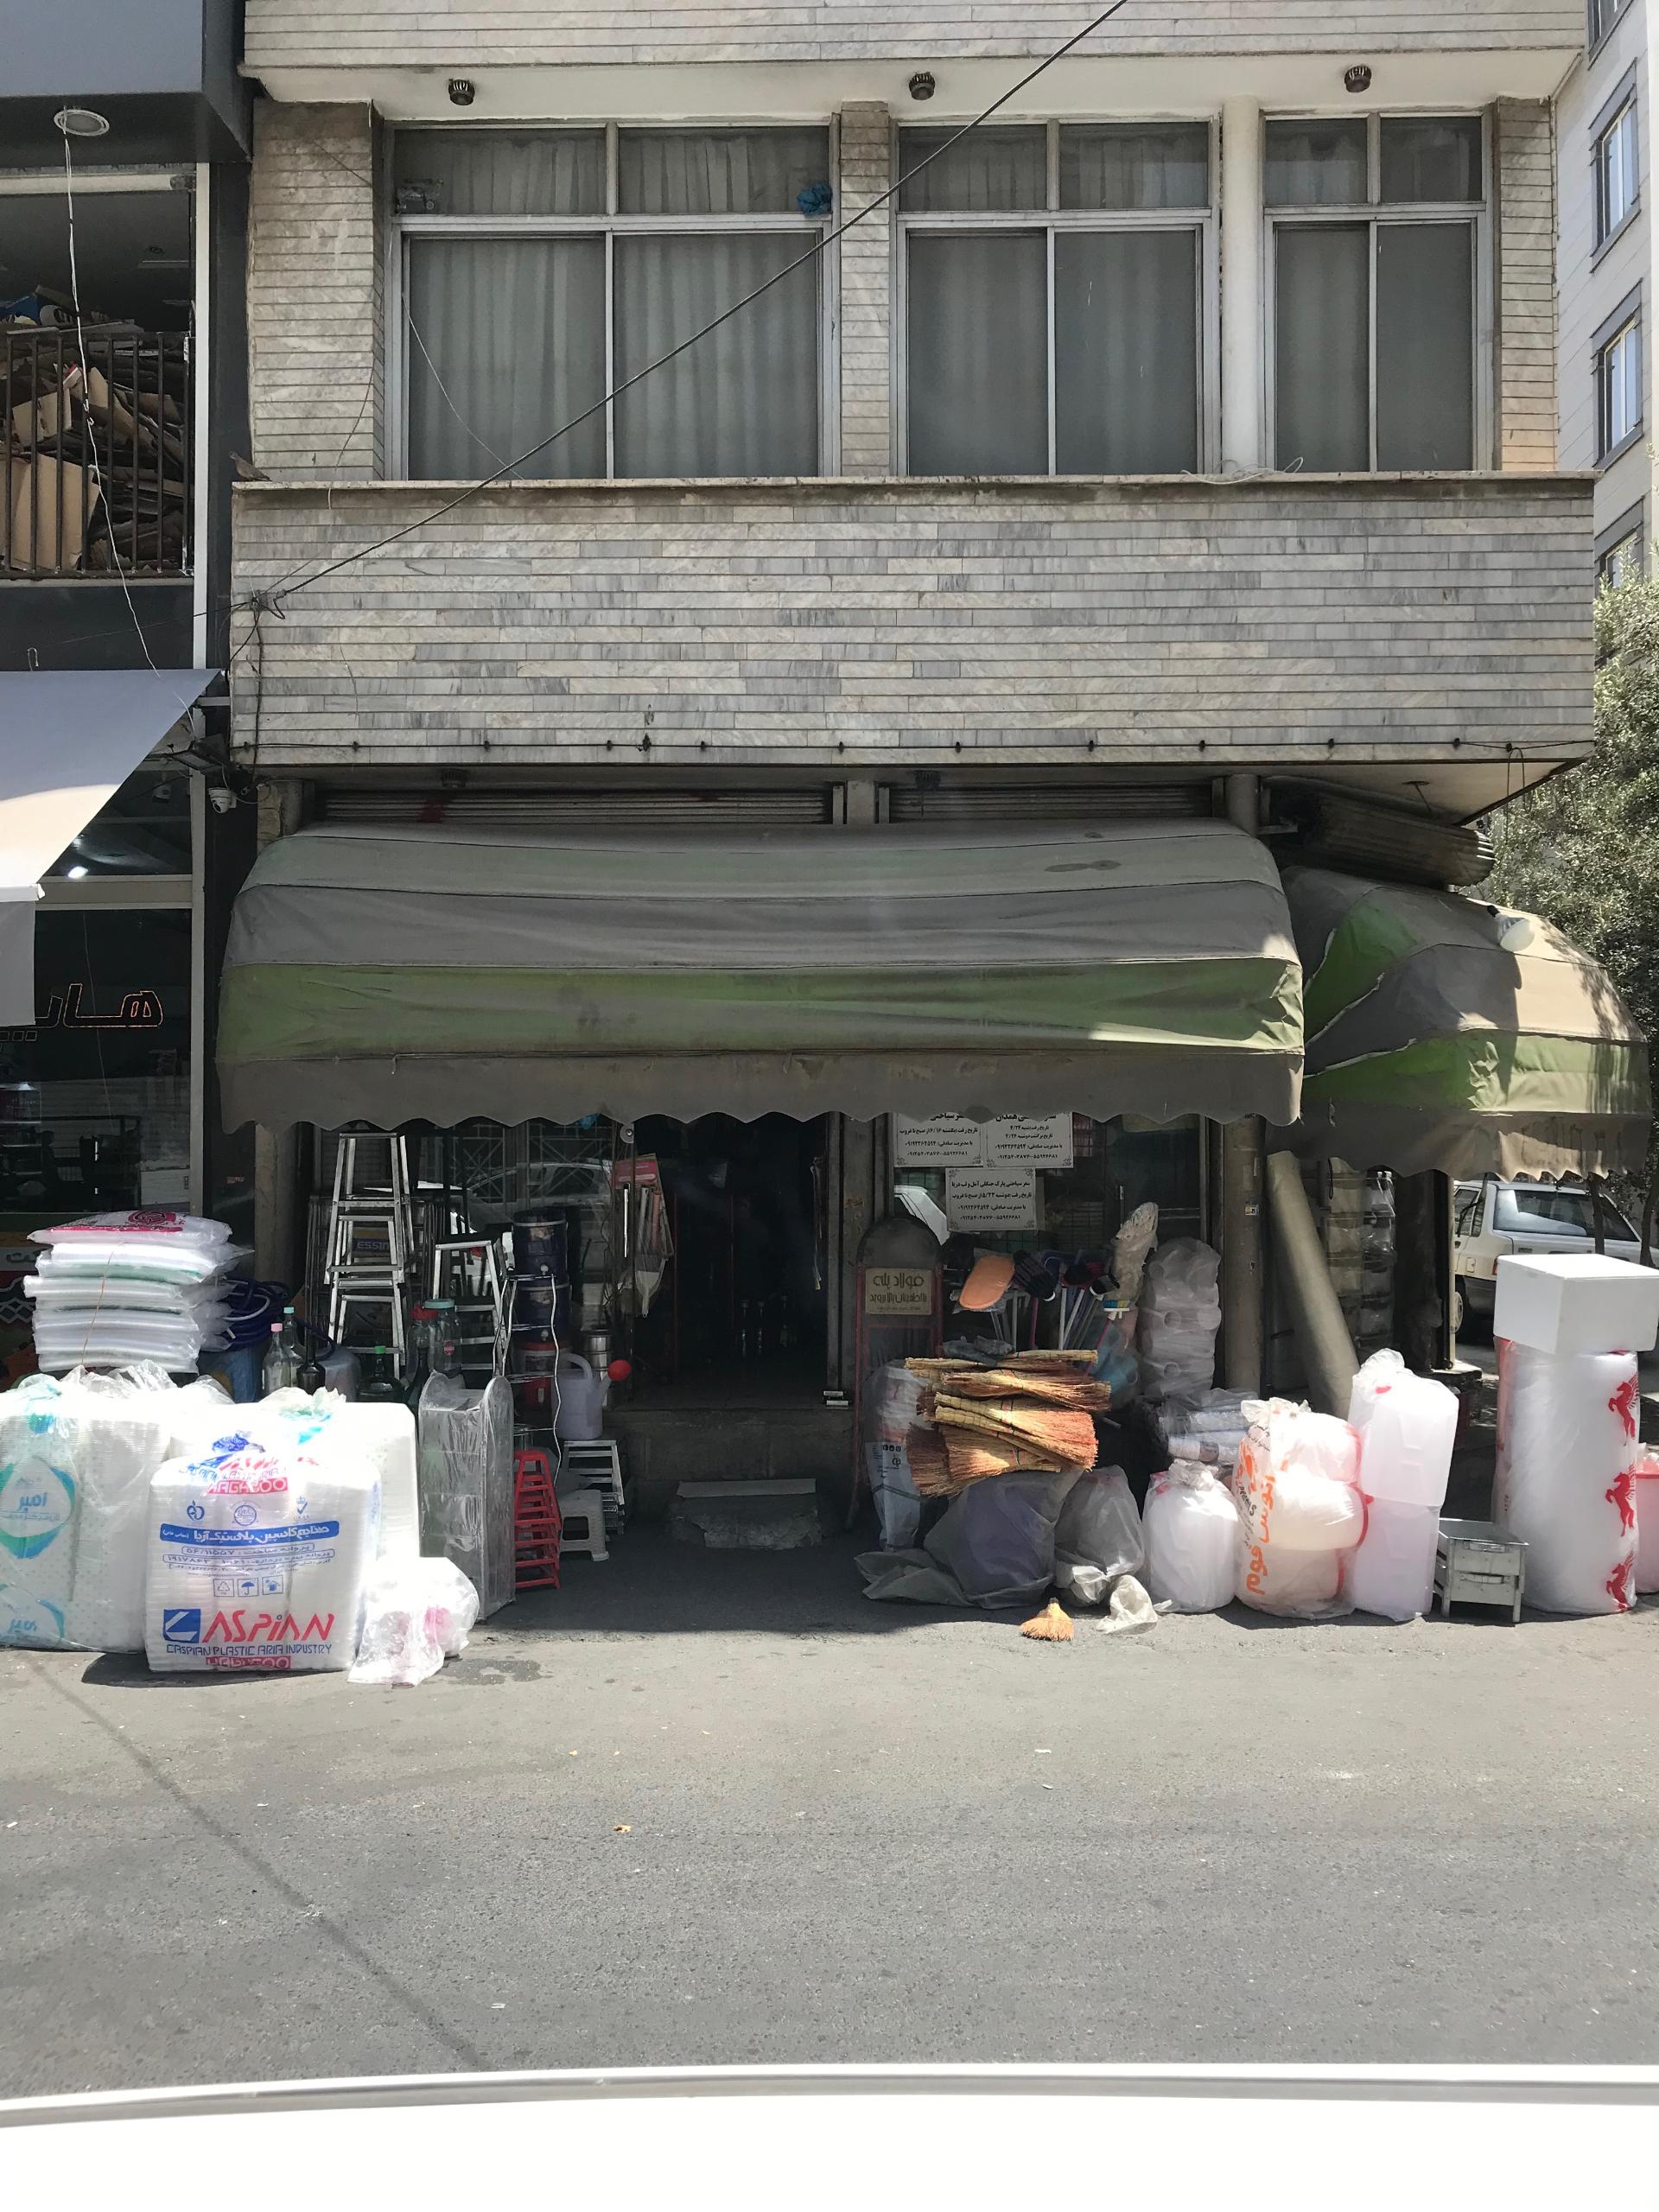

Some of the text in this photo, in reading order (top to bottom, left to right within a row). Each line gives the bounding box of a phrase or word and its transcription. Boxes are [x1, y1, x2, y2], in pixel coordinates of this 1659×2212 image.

[873, 1272, 925, 1290] فولاد پله
[18, 1492, 48, 1513] امبر
[193, 1529, 211, 1543] آریا
[209, 1530, 255, 1544] پلاستیک
[256, 1528, 298, 1544] کاسپین
[296, 1527, 330, 1540] صنایع
[1246, 1545, 1268, 1596] فوم
[166, 1643, 333, 1656] CASPIAN PLASTIC ARIA INDUSTRY
